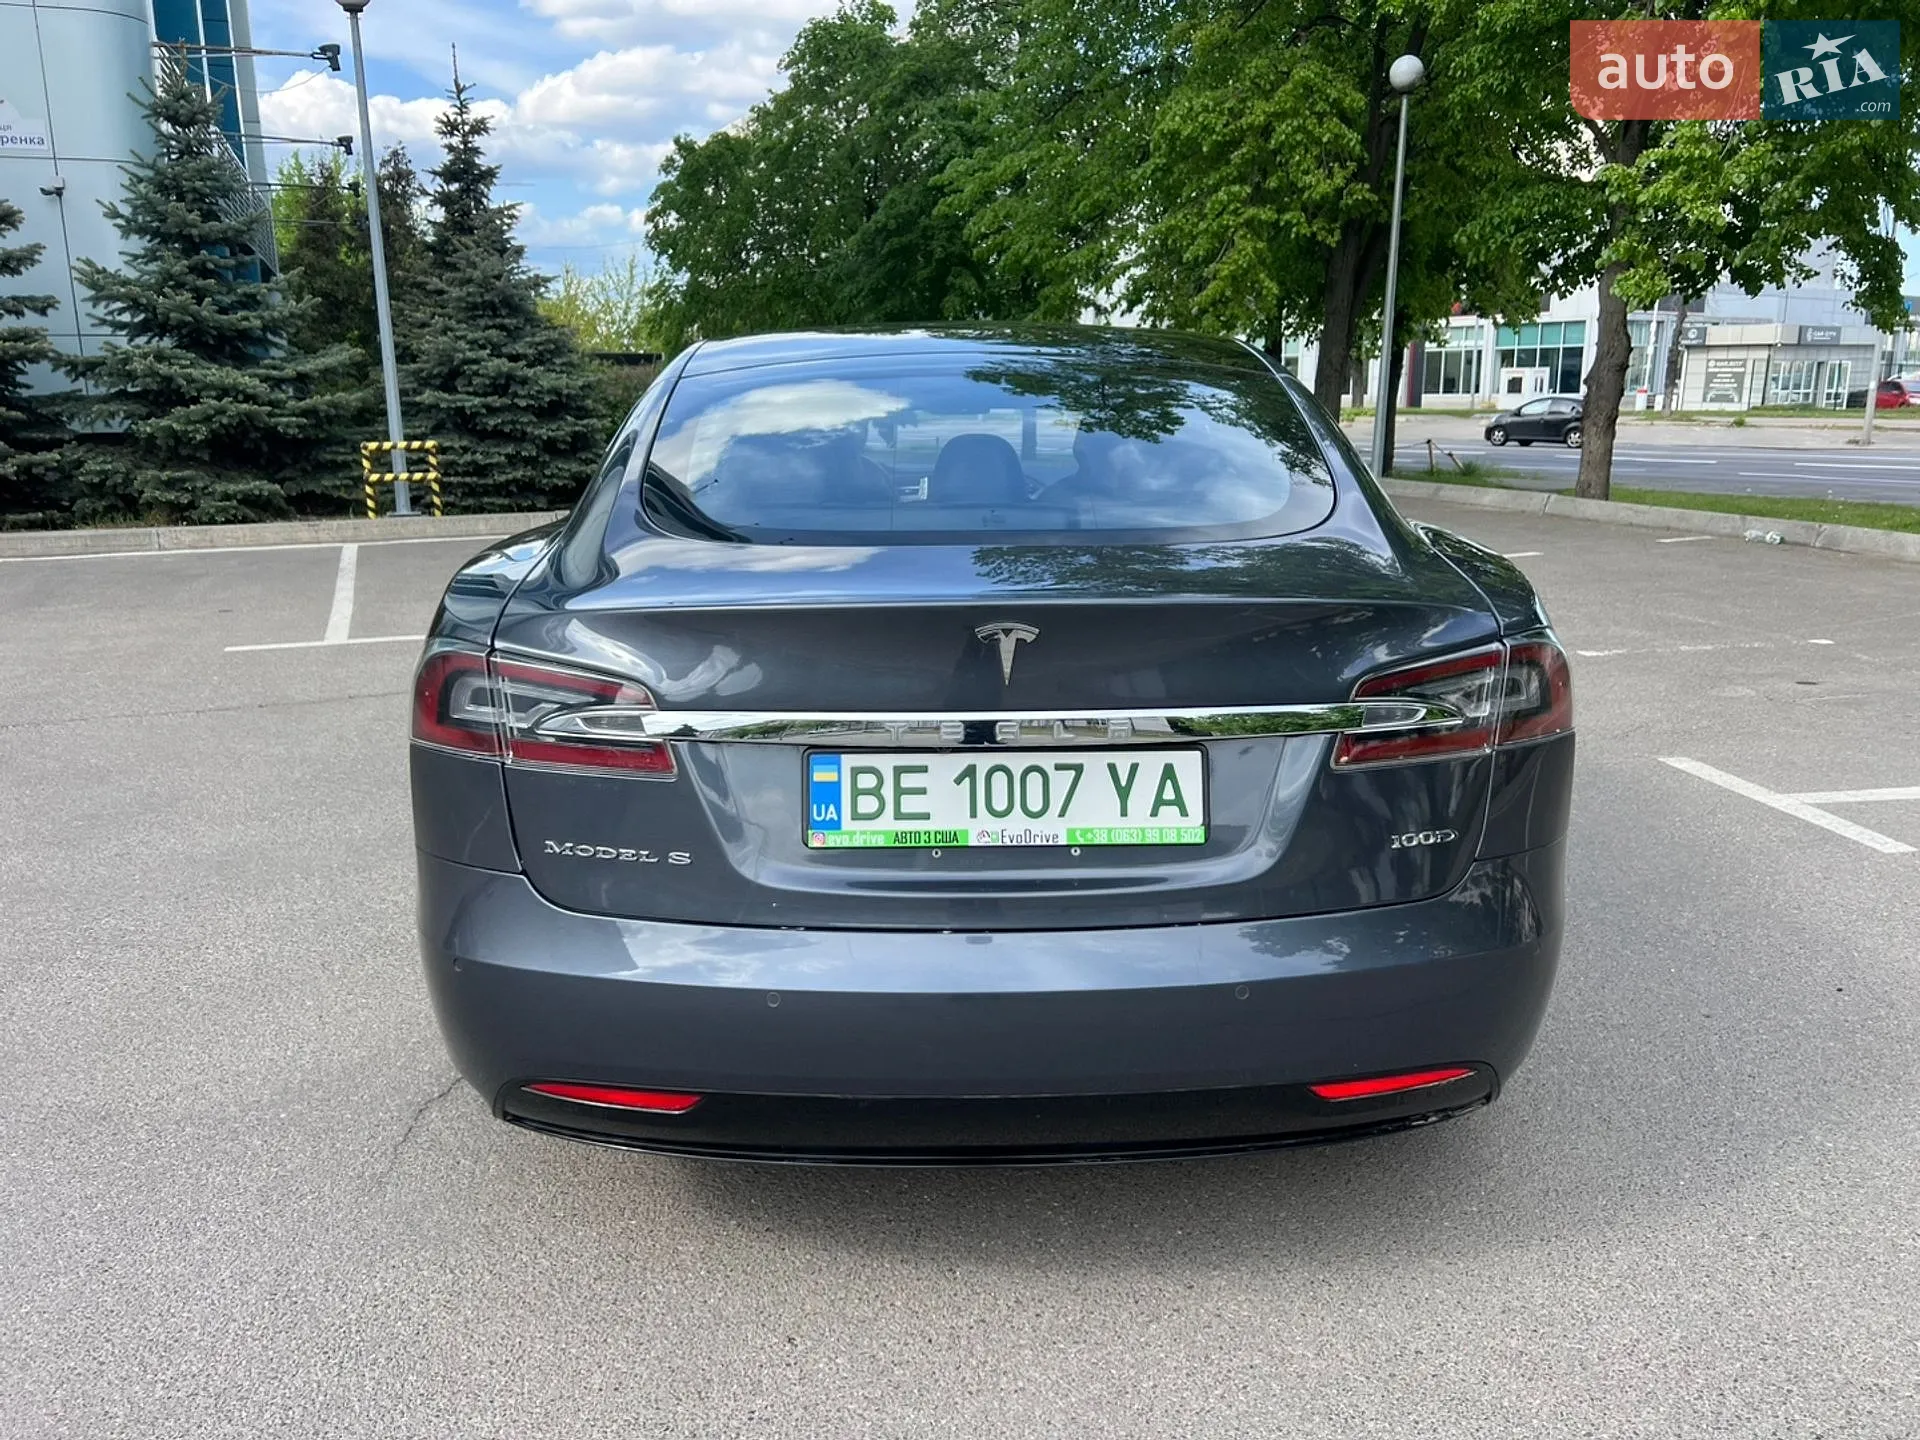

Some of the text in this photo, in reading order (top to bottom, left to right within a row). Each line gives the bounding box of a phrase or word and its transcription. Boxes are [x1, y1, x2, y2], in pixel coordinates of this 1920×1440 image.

[850, 762, 1189, 821] BE 1007 YA
[813, 804, 838, 821] UA
[893, 831, 921, 844] АВТО
[934, 830, 959, 843] США
[1001, 828, 1060, 844] EvoDrive
[1391, 829, 1459, 849] 100D
[544, 840, 692, 865] MODEL S
